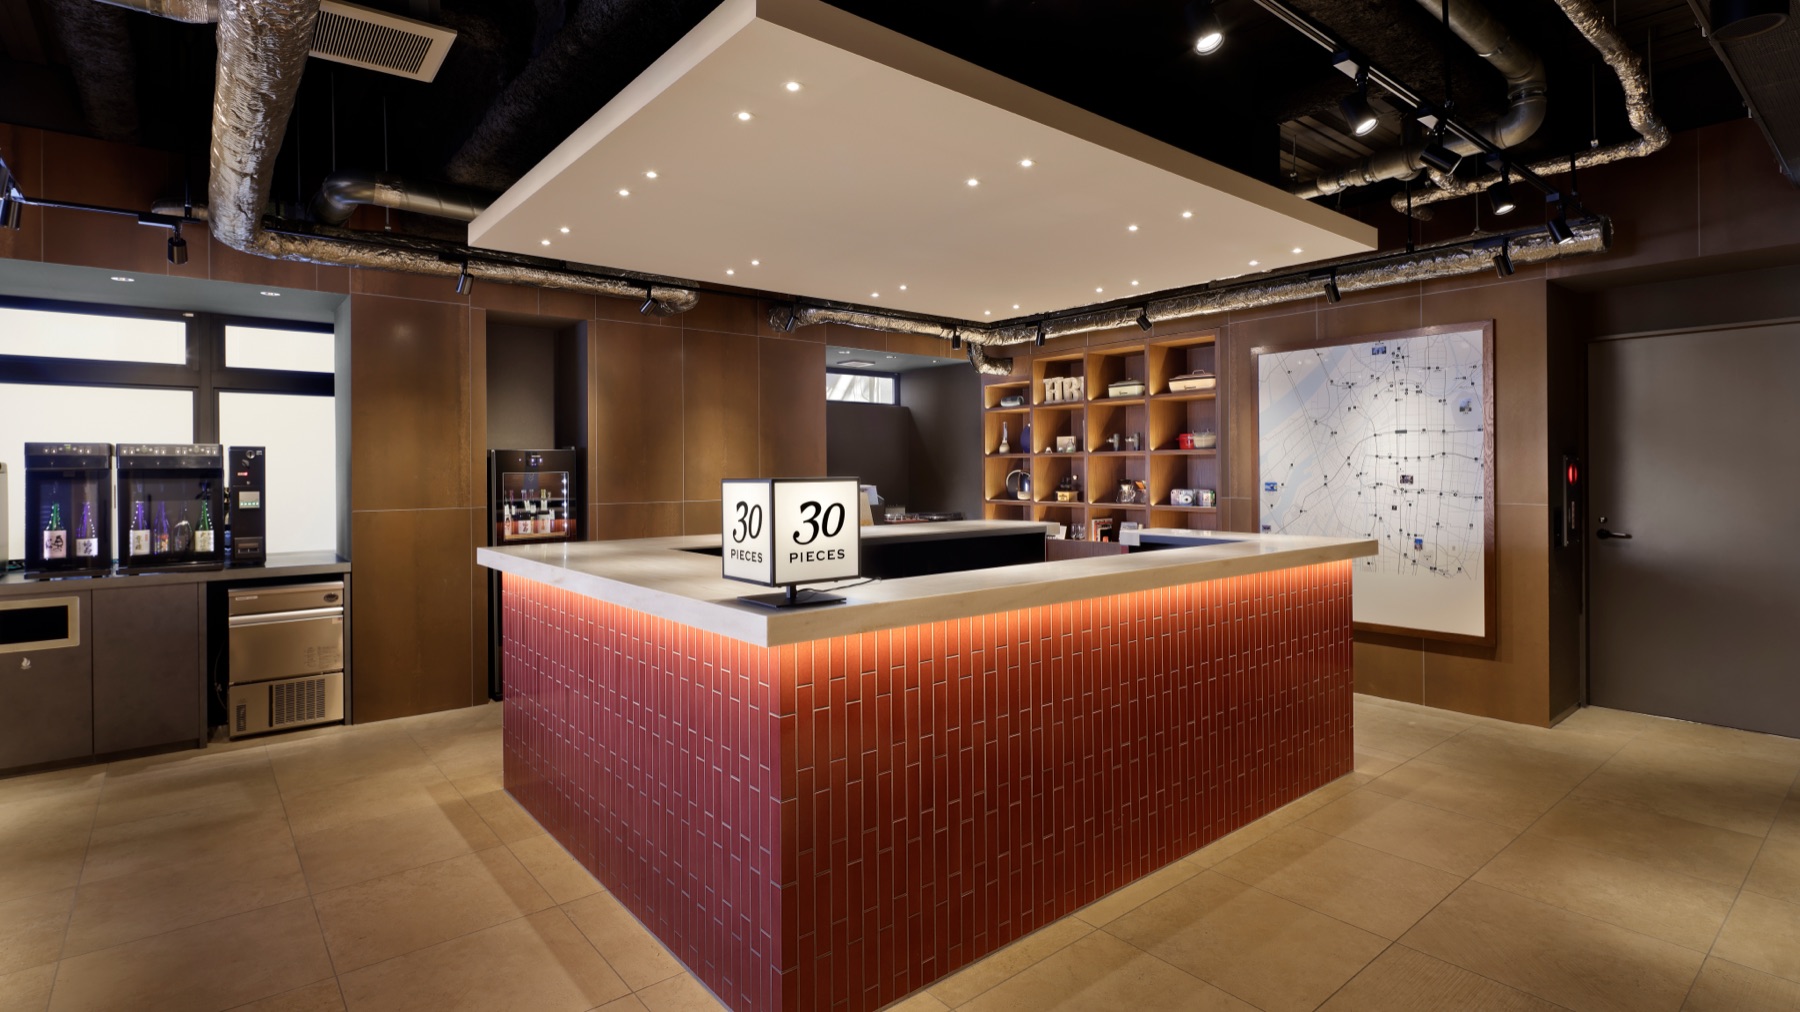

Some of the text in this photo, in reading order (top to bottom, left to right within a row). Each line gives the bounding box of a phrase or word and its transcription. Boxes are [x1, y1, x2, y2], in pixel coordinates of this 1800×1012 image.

[733, 501, 762, 543] 30
[793, 501, 845, 545] 30
[731, 549, 762, 563] PIECES
[790, 549, 845, 563] PIECES
